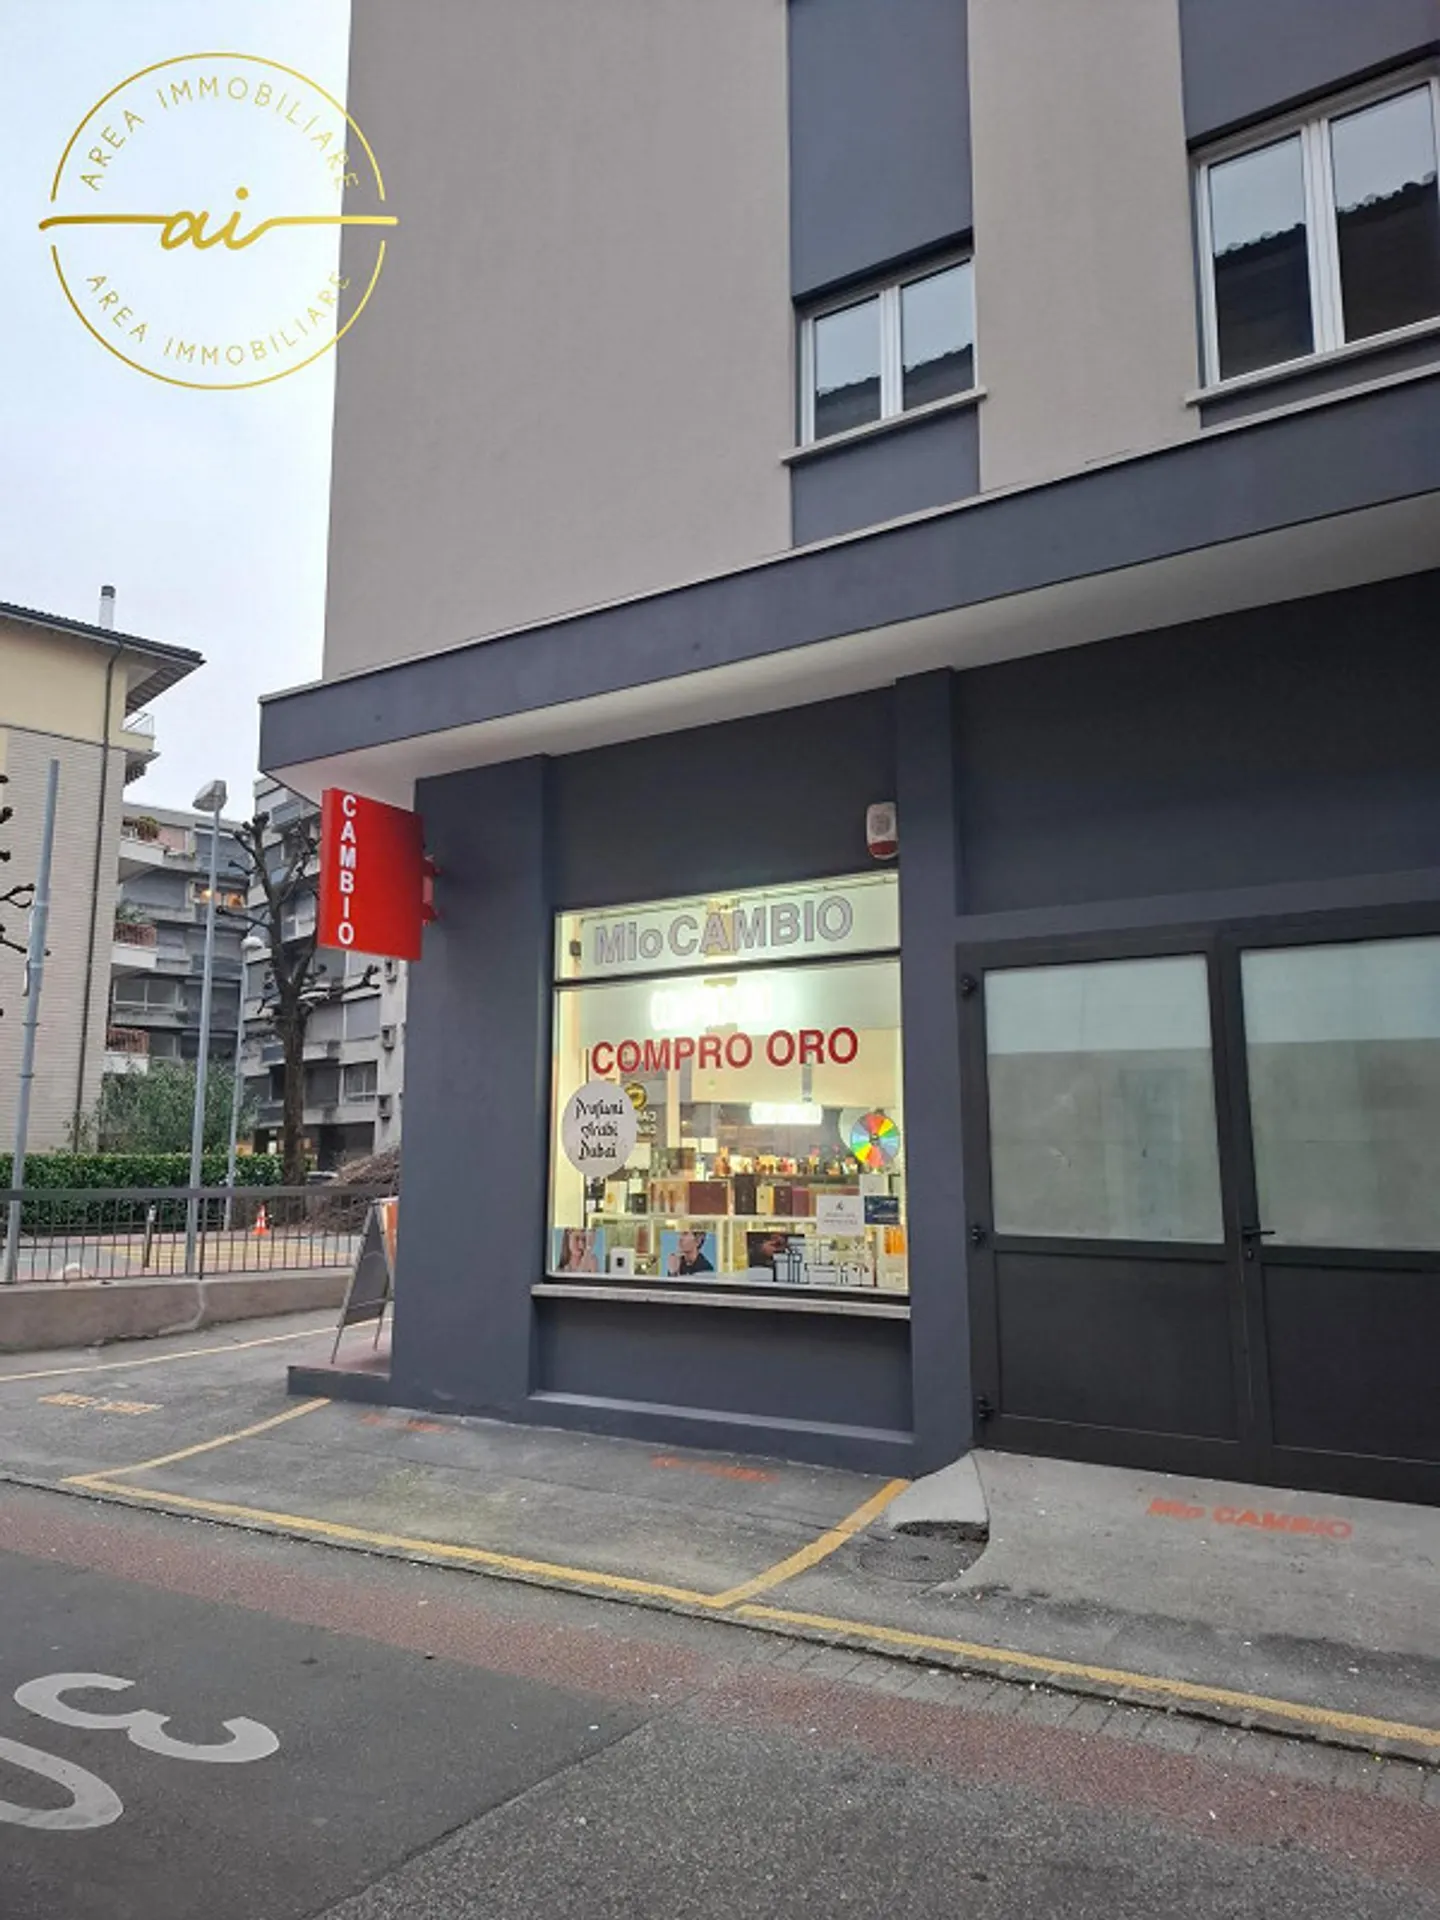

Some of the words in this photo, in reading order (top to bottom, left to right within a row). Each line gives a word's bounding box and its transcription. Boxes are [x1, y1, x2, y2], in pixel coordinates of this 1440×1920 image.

[337, 794, 357, 945] CAMBIO
[591, 1032, 753, 1074] COMPRO
[766, 1026, 859, 1067] ORO
